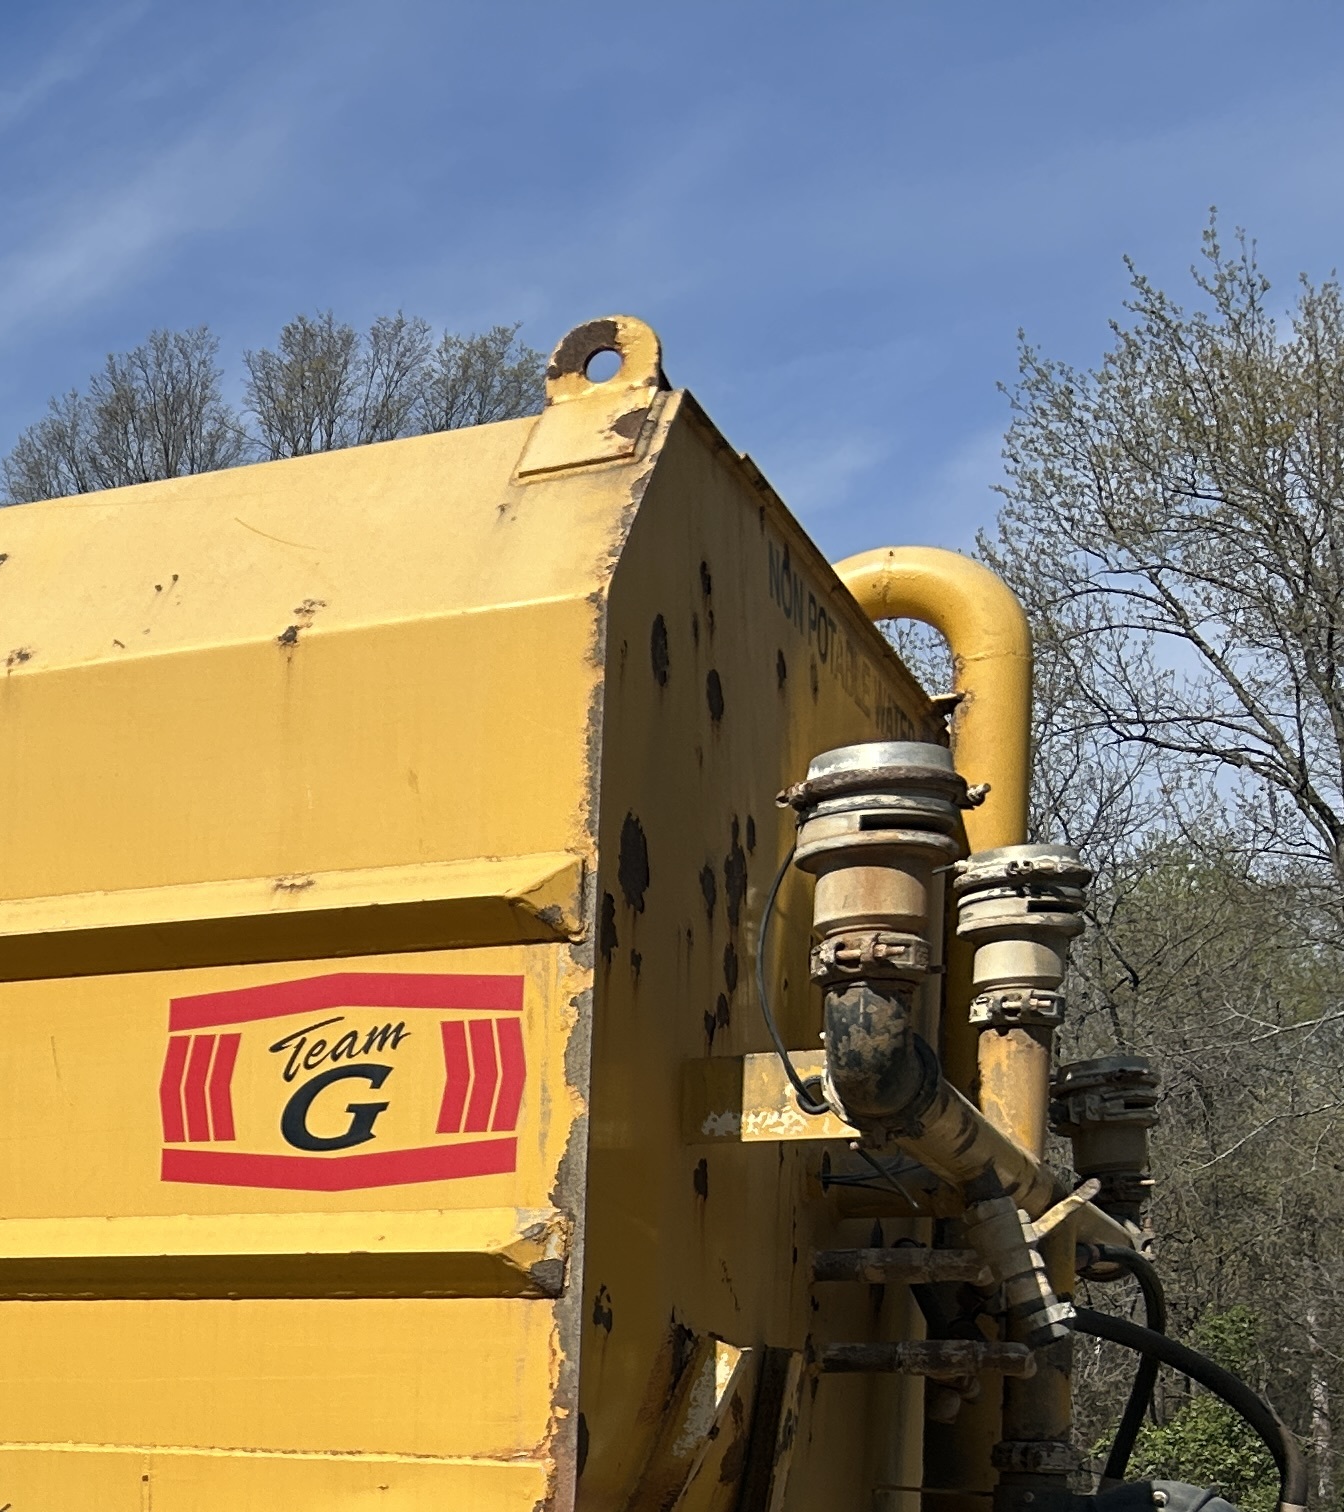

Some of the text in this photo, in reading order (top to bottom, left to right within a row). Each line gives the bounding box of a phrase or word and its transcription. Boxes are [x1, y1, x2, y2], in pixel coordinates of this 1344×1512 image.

[768, 541, 804, 634] NON
[269, 1016, 411, 1082] Team
[281, 1063, 394, 1152] G
